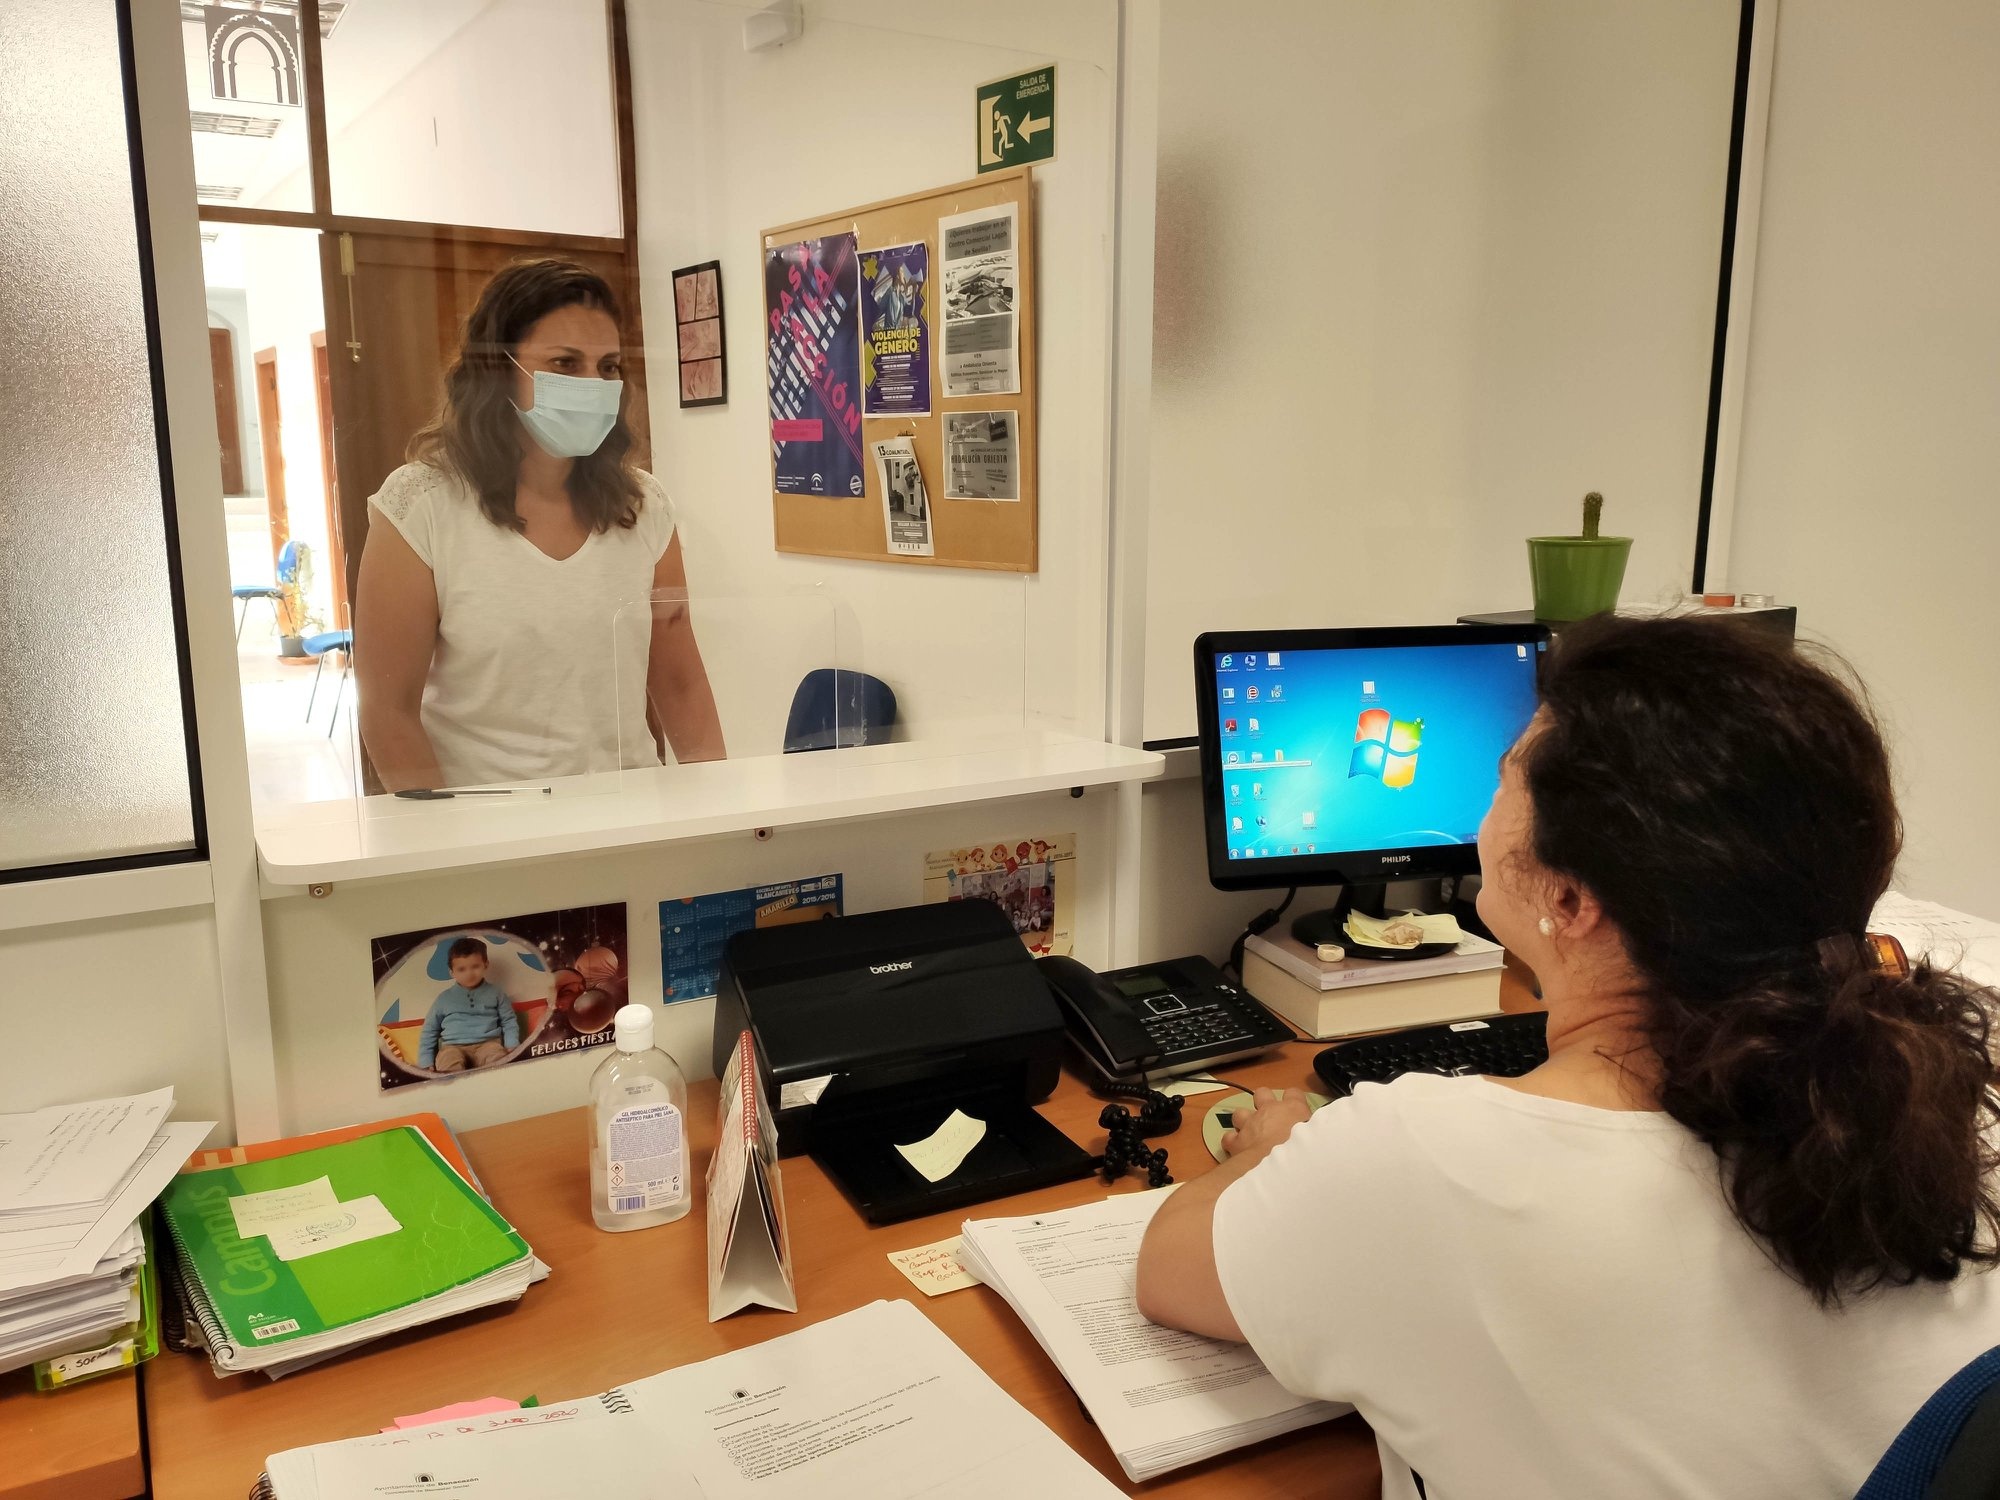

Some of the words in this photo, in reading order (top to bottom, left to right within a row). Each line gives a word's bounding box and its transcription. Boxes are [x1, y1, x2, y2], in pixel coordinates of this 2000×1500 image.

[1020, 76, 1038, 89] SALIDA
[1038, 74, 1046, 83] DE
[1016, 83, 1050, 99] EMERGENCIA
[948, 240, 965, 248] Centro
[966, 234, 990, 245] Comercial
[871, 328, 909, 341] VIOLENCIA
[910, 327, 921, 339] DE
[983, 454, 1008, 464] ORIENTA
[1381, 855, 1411, 863] PHILIPS
[756, 887, 800, 900] BLANCANIEVES
[802, 893, 836, 904] 2015/2016
[760, 896, 795, 918] AMARILLO
[870, 961, 912, 974] brother
[531, 1037, 579, 1057] FELICES
[248, 1312, 264, 1320] A4
[754, 1385, 787, 1399] Benacazón
[374, 1483, 425, 1492] Ayuntamiento
[437, 1477, 479, 1487] Benacazón
